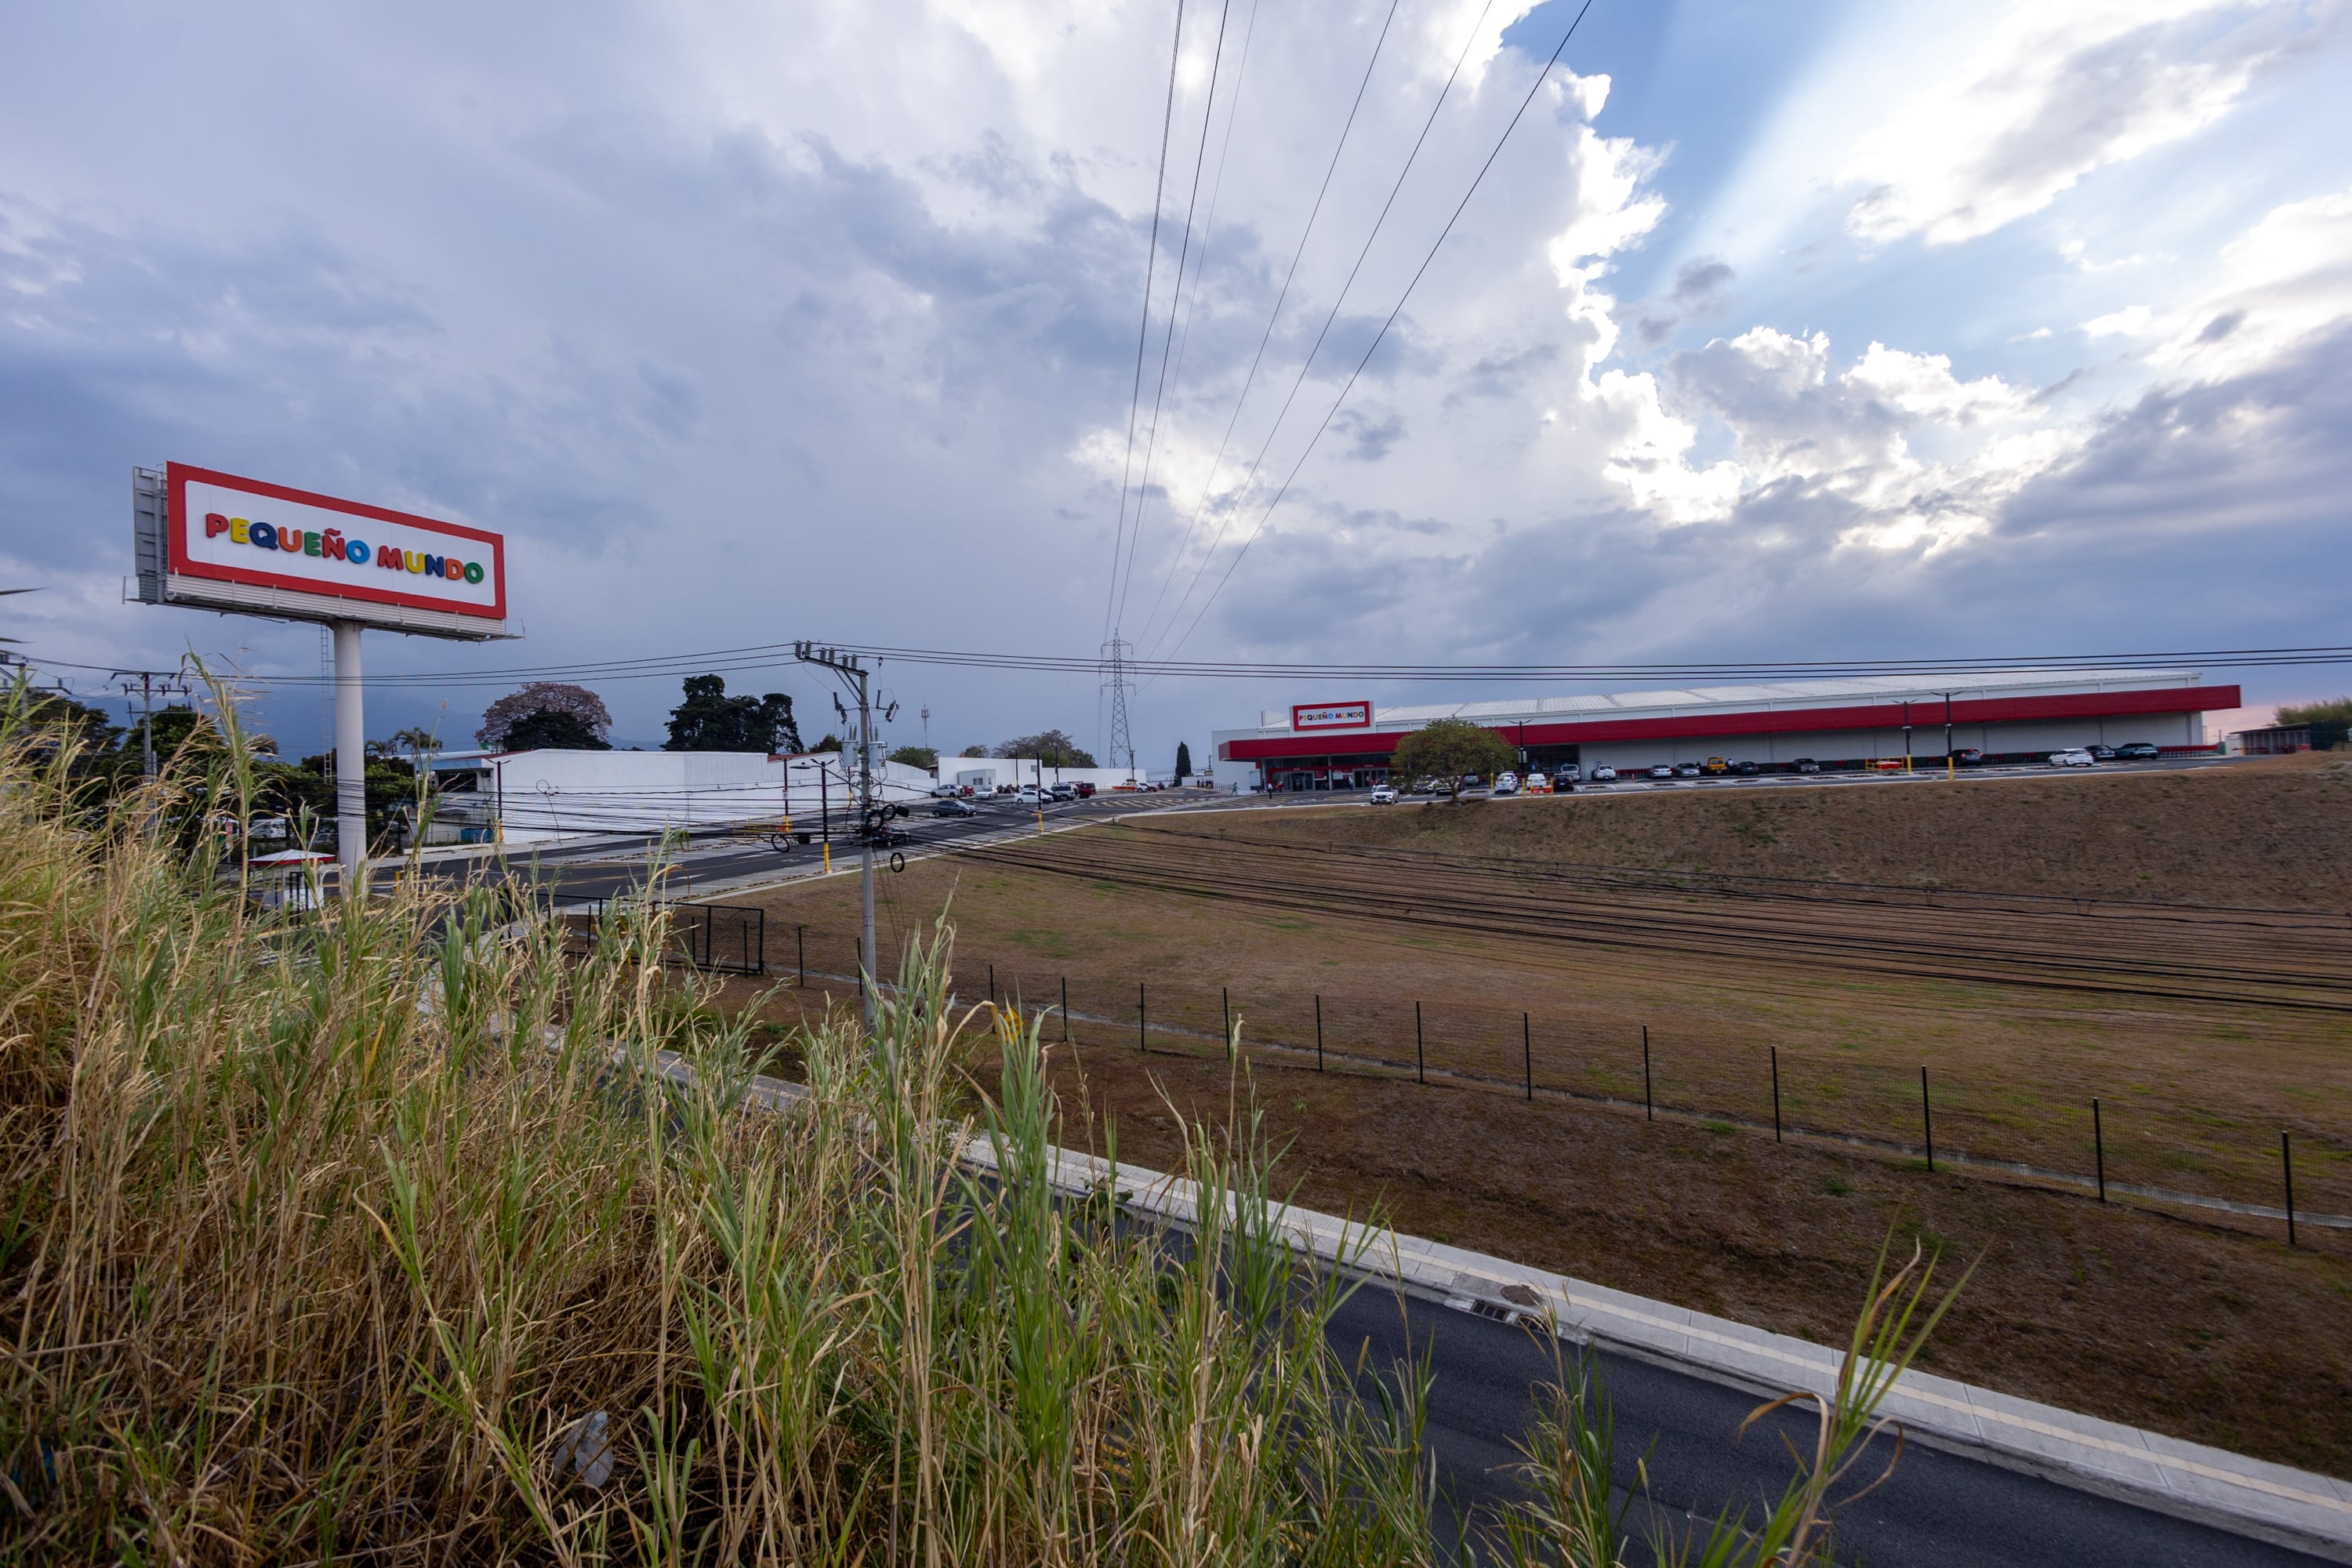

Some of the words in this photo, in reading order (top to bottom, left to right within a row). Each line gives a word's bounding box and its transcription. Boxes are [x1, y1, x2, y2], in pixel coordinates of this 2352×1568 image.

[205, 513, 371, 564] PEQUEÑO
[377, 545, 485, 584] MUNDO
[1298, 712, 1334, 721] PEQUEÑO
